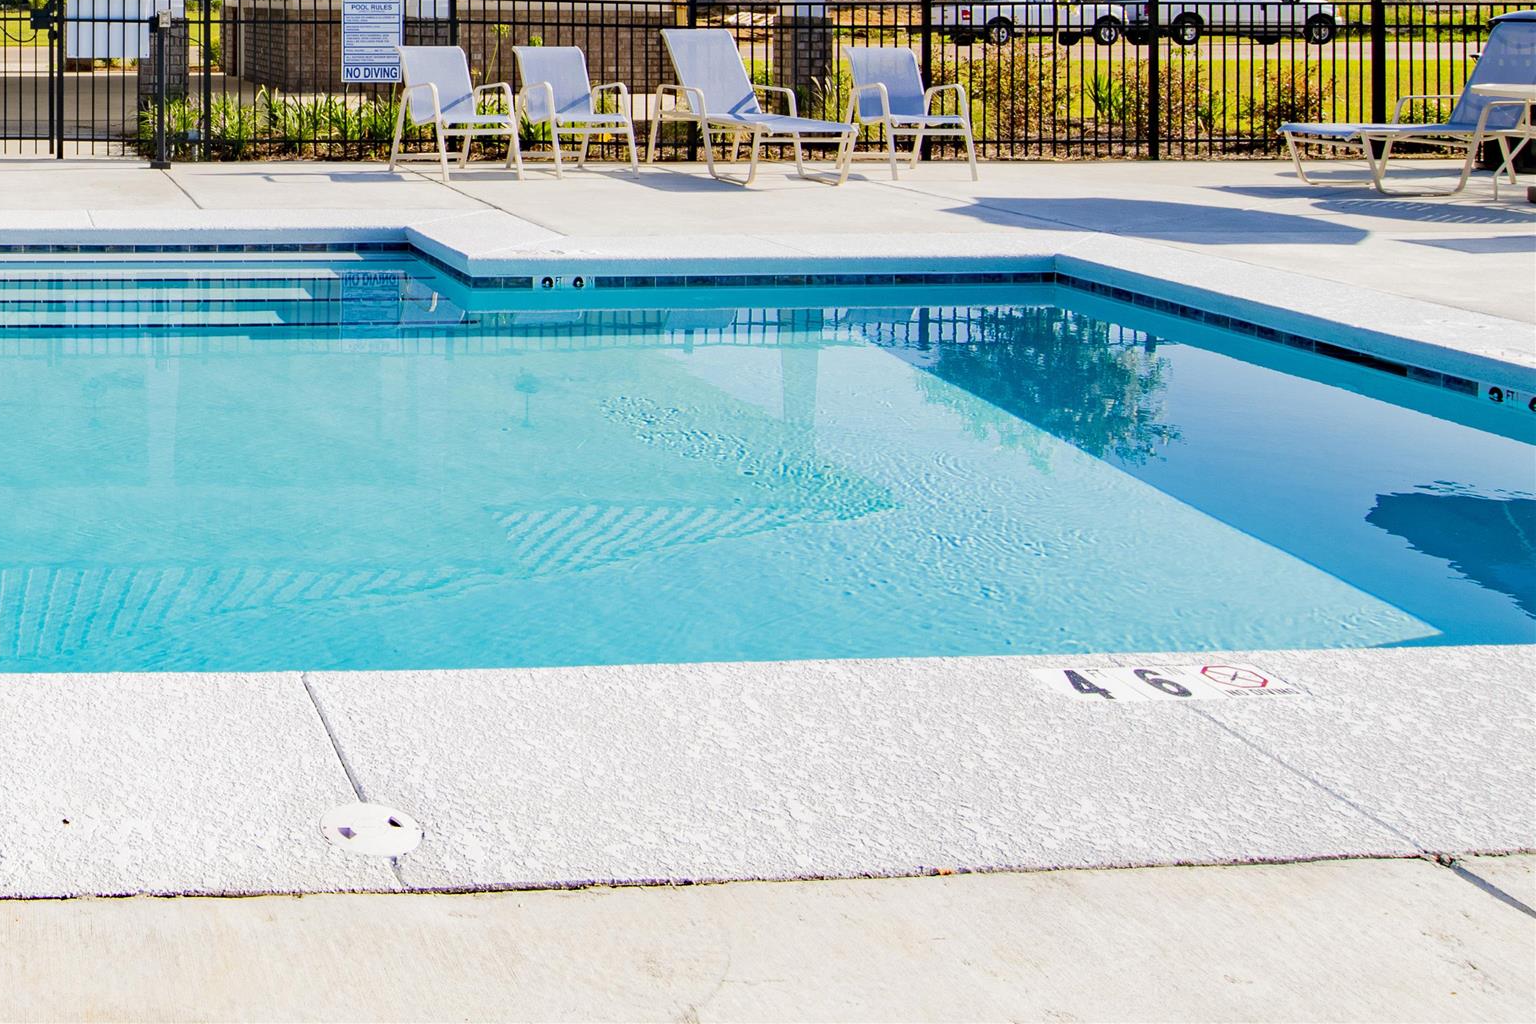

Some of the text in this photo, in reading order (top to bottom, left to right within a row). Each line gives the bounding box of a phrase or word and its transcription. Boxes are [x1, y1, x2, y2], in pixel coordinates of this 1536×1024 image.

[346, 67, 398, 79] NO DIVING
[1063, 669, 1116, 700] 4
[1133, 668, 1193, 698] 6
[1227, 687, 1301, 696] NO DIVING
